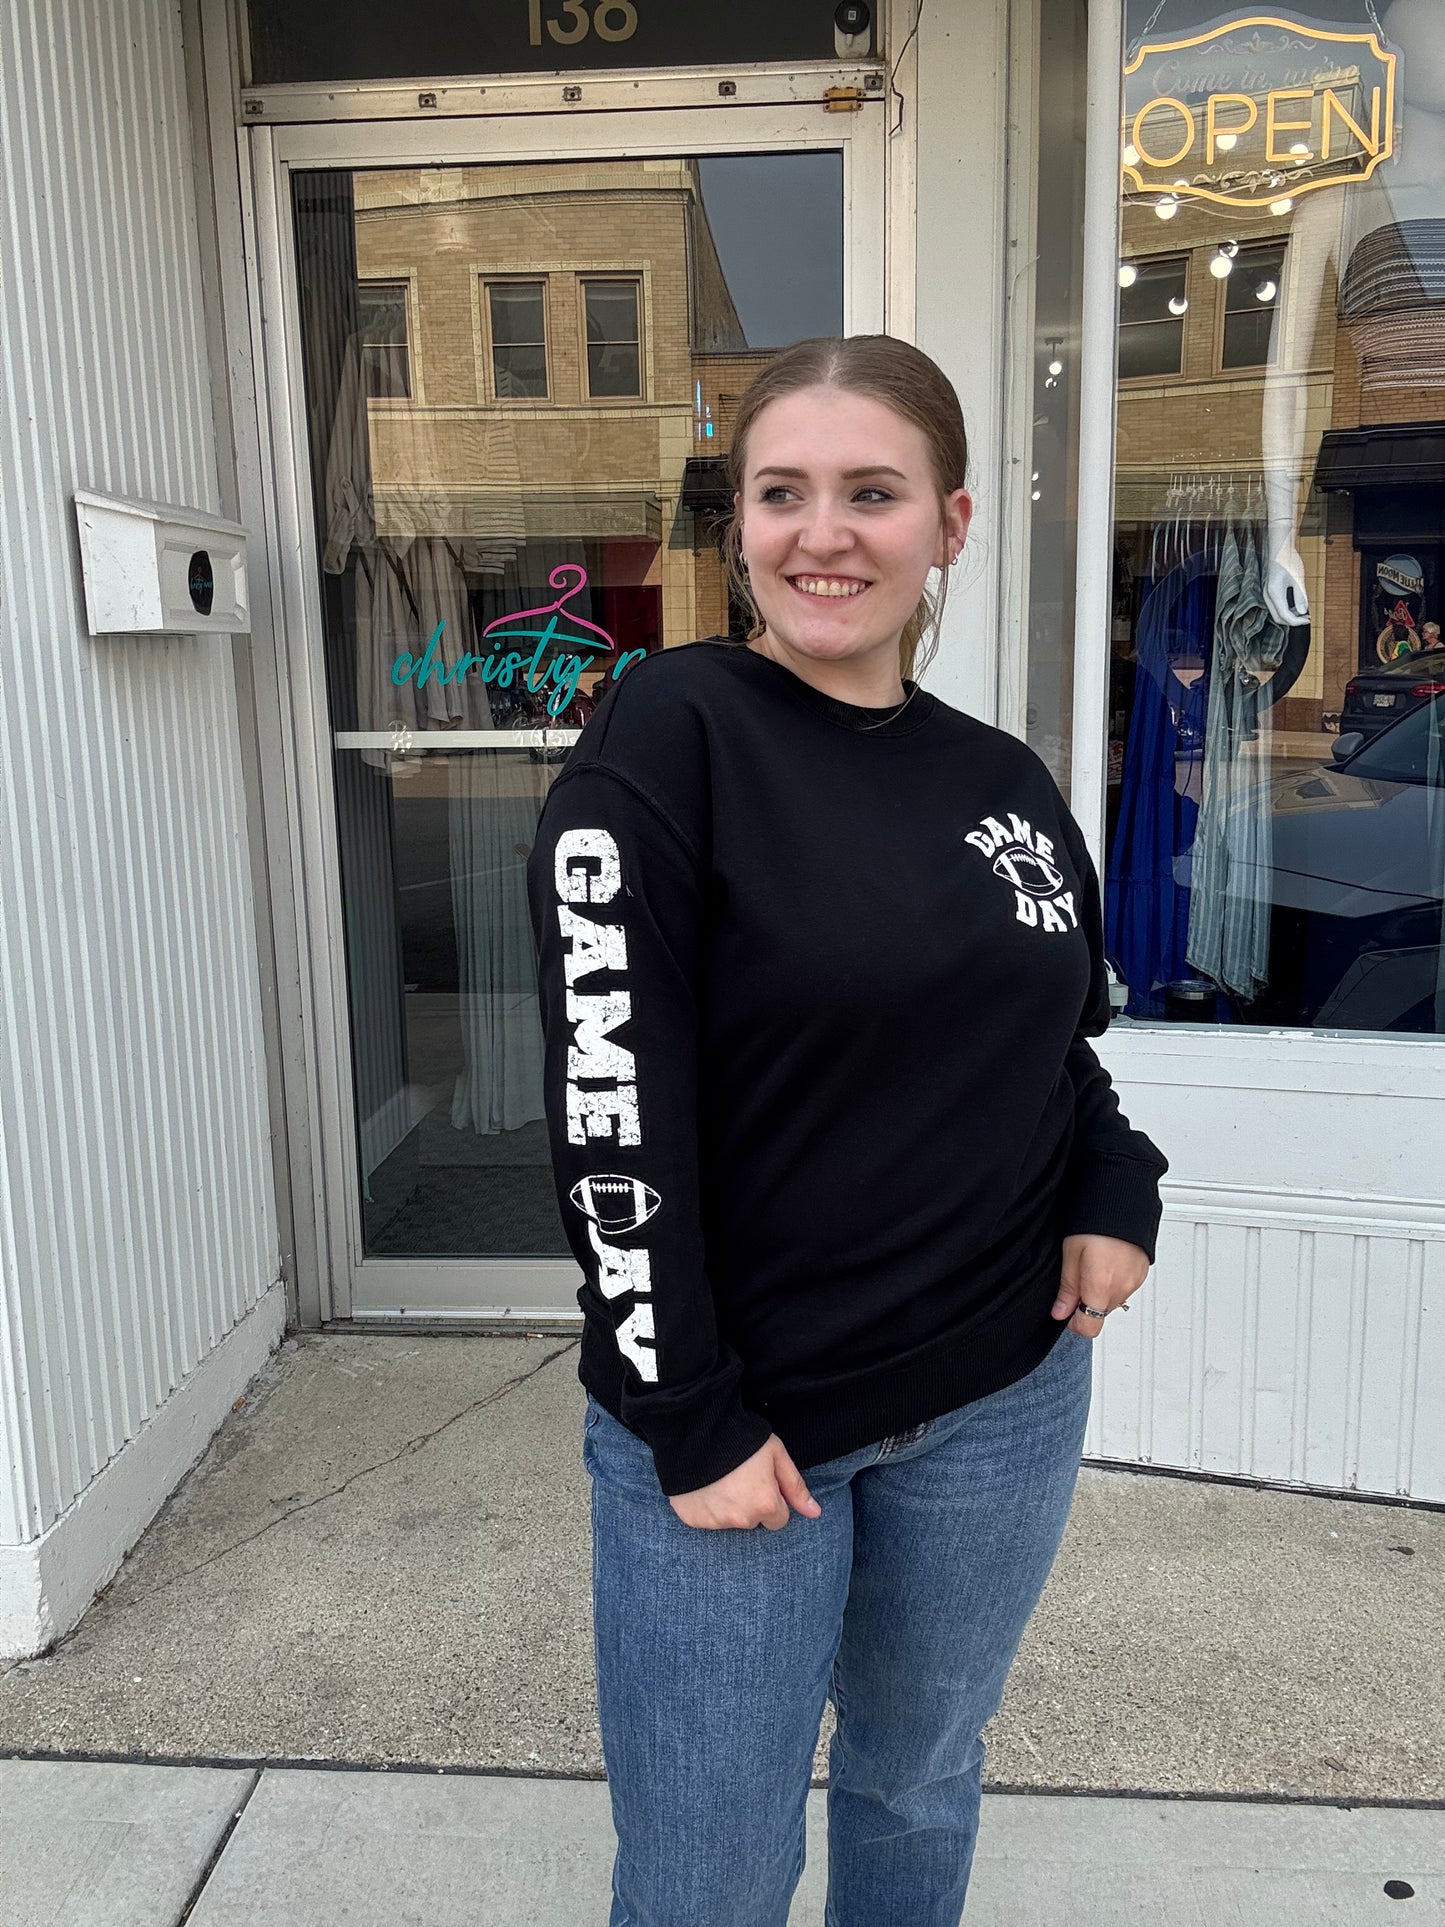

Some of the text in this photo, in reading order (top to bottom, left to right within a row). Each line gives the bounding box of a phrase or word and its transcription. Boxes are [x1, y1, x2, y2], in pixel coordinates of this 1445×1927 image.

[528, 0, 638, 46] 138
[1132, 87, 1380, 168] OPEN
[391, 616, 597, 716] christy
[964, 813, 1055, 865] GAME
[1015, 891, 1078, 932] DAY
[555, 829, 642, 1147] GAME
